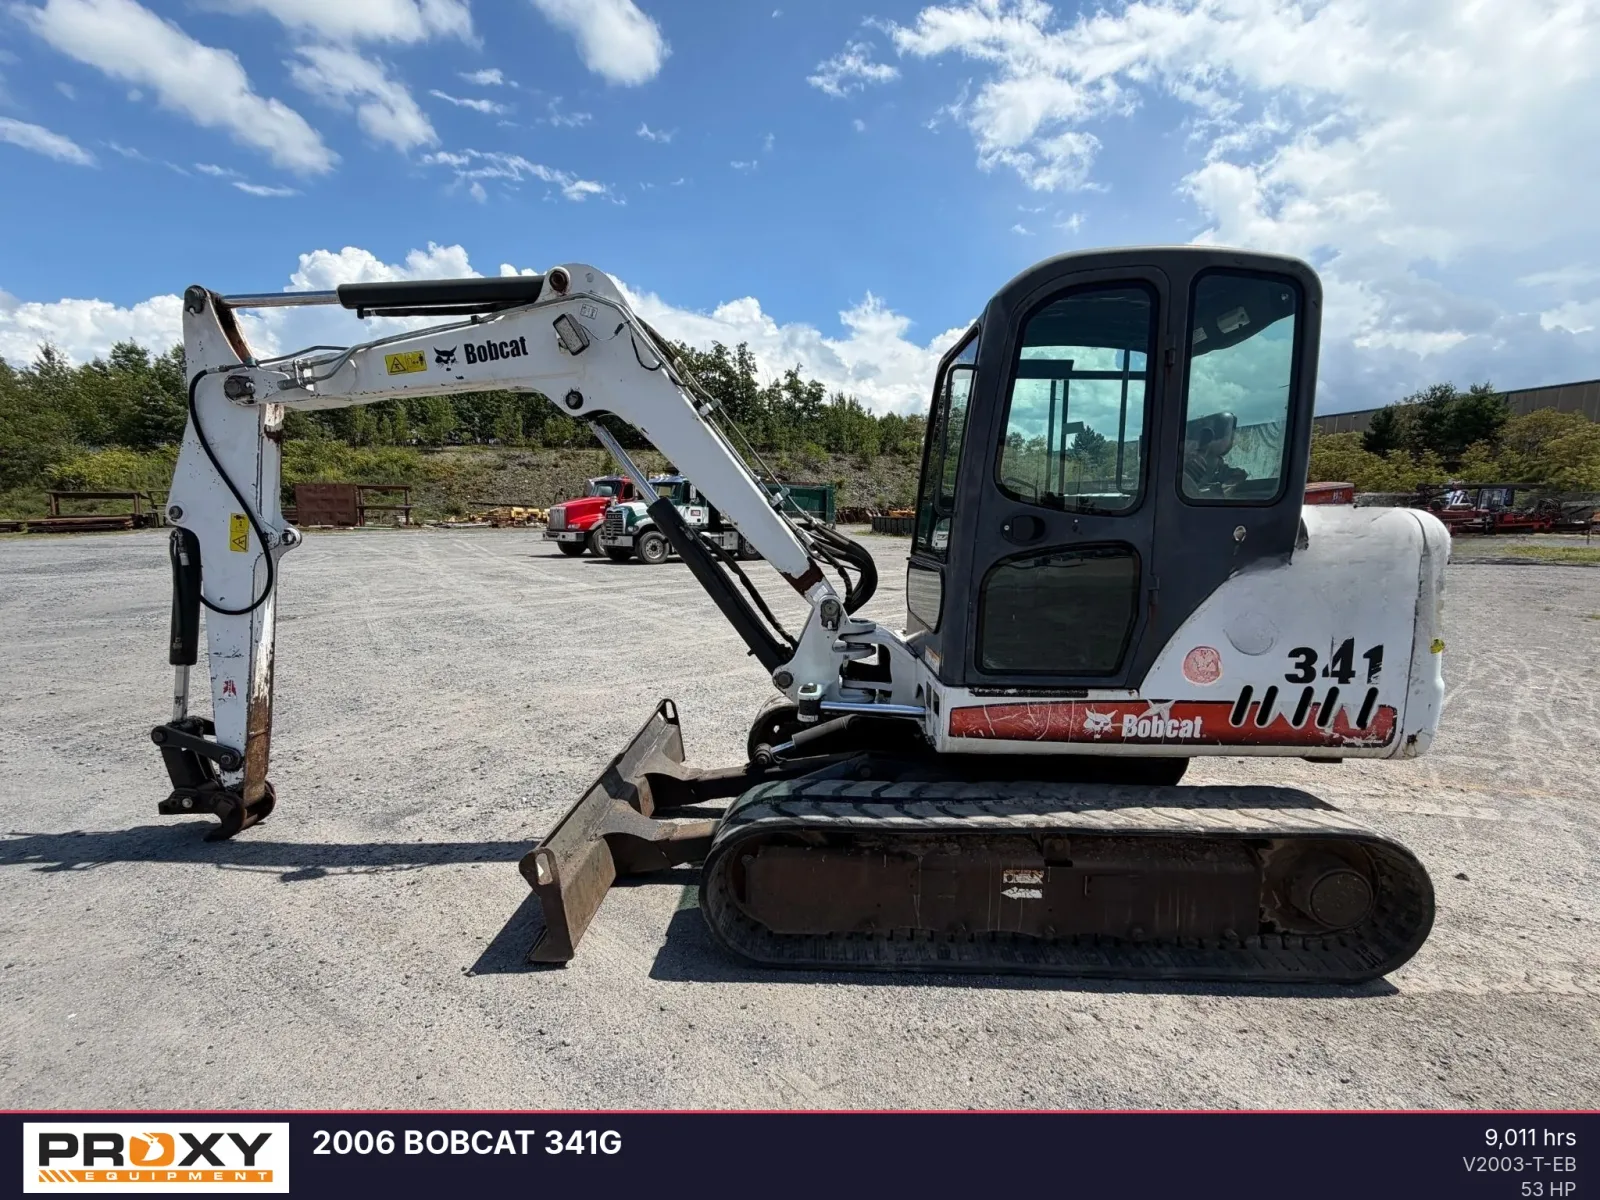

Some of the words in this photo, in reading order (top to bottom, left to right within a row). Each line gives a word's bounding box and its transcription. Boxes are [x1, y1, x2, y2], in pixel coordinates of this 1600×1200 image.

[464, 336, 528, 364] Bobcat
[1284, 637, 1384, 685] 341
[1121, 714, 1203, 738] Bobcat
